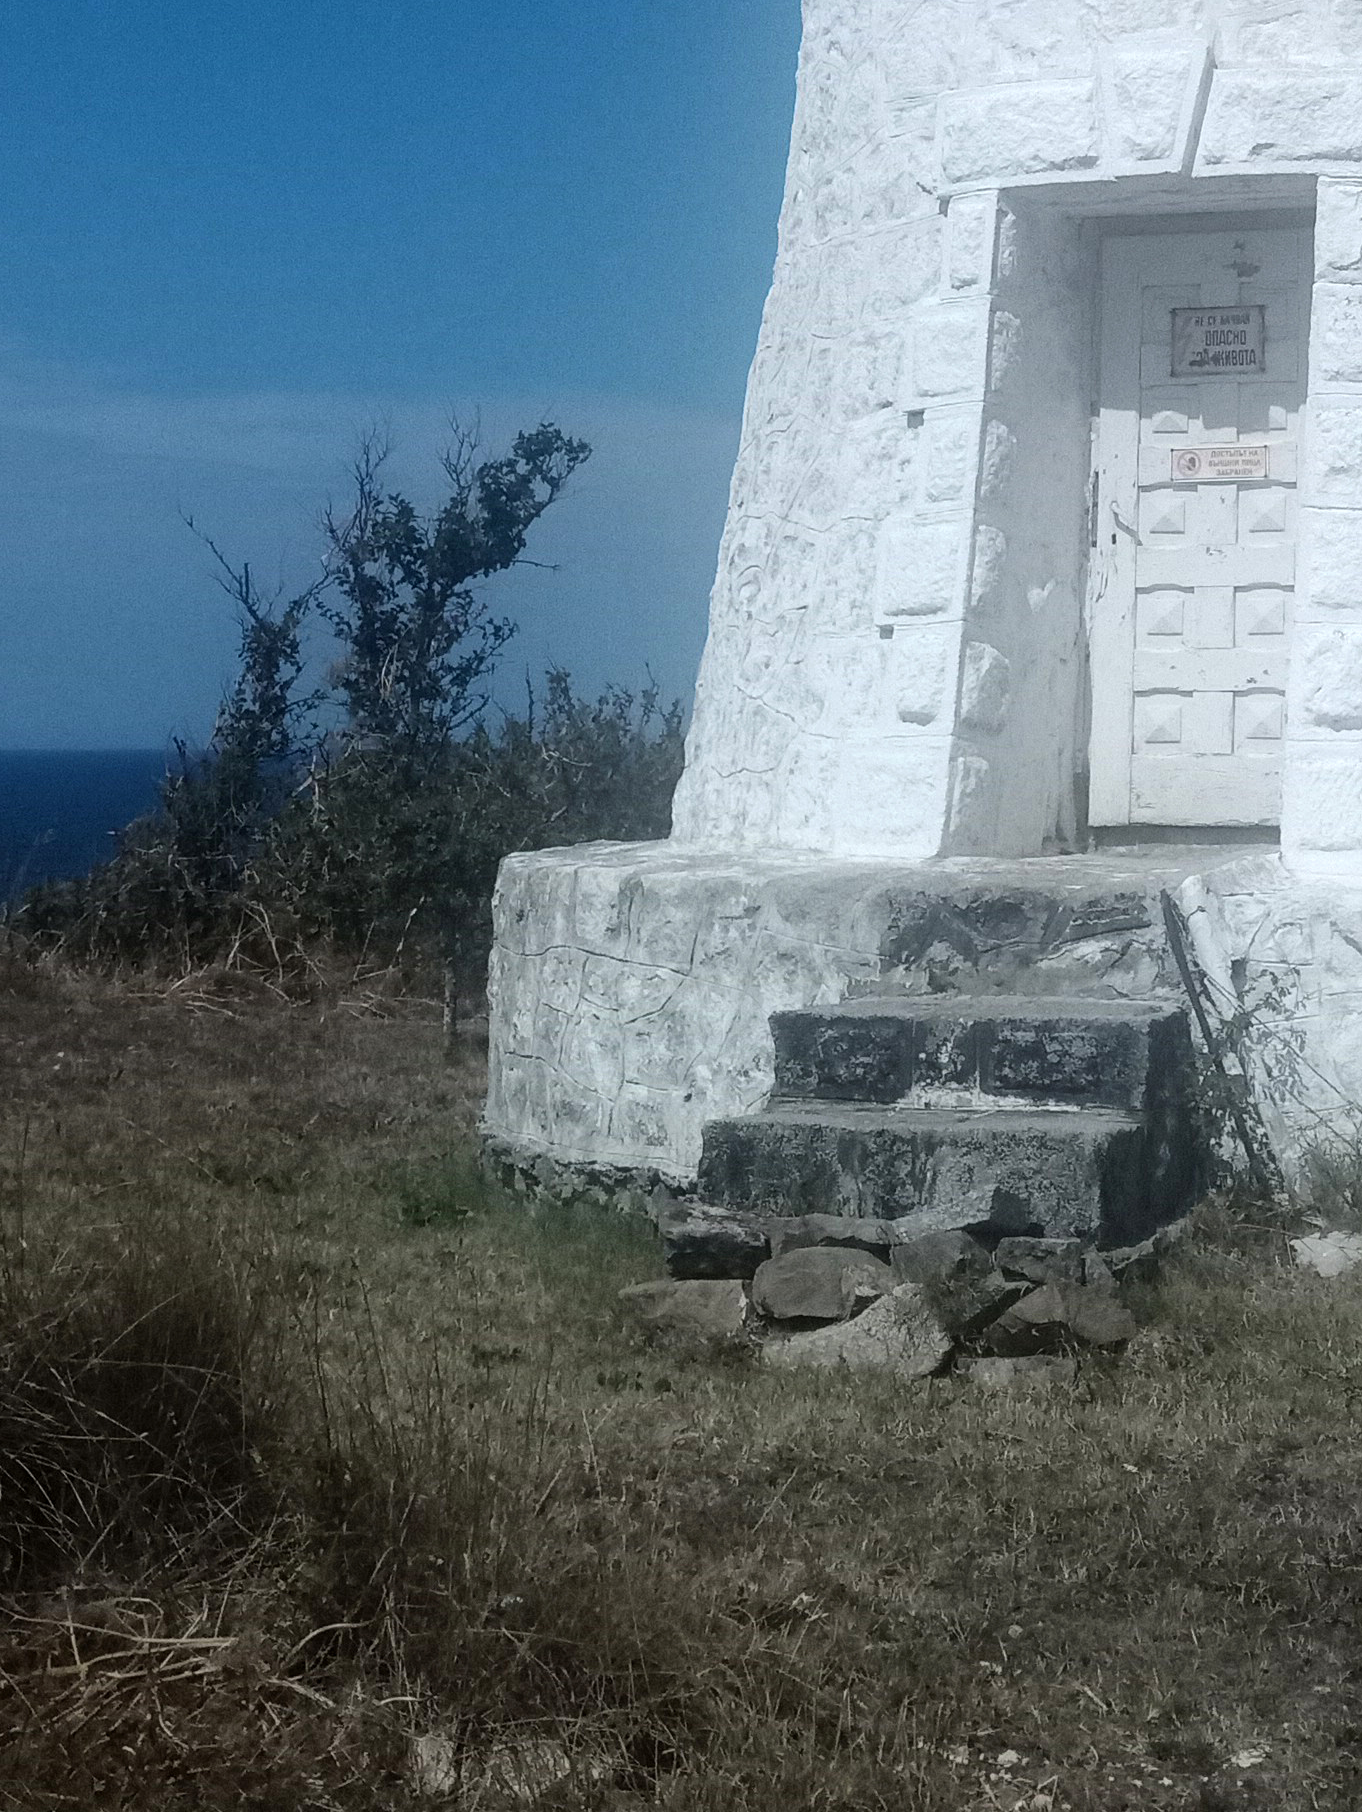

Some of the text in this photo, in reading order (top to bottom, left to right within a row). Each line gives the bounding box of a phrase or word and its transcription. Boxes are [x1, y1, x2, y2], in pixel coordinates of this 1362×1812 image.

[1205, 329, 1247, 346] ОПАСНО
[1211, 449, 1259, 458] ДОСТЪПЪТ НА
[1216, 468, 1253, 476] ЗАБРАНЕН
